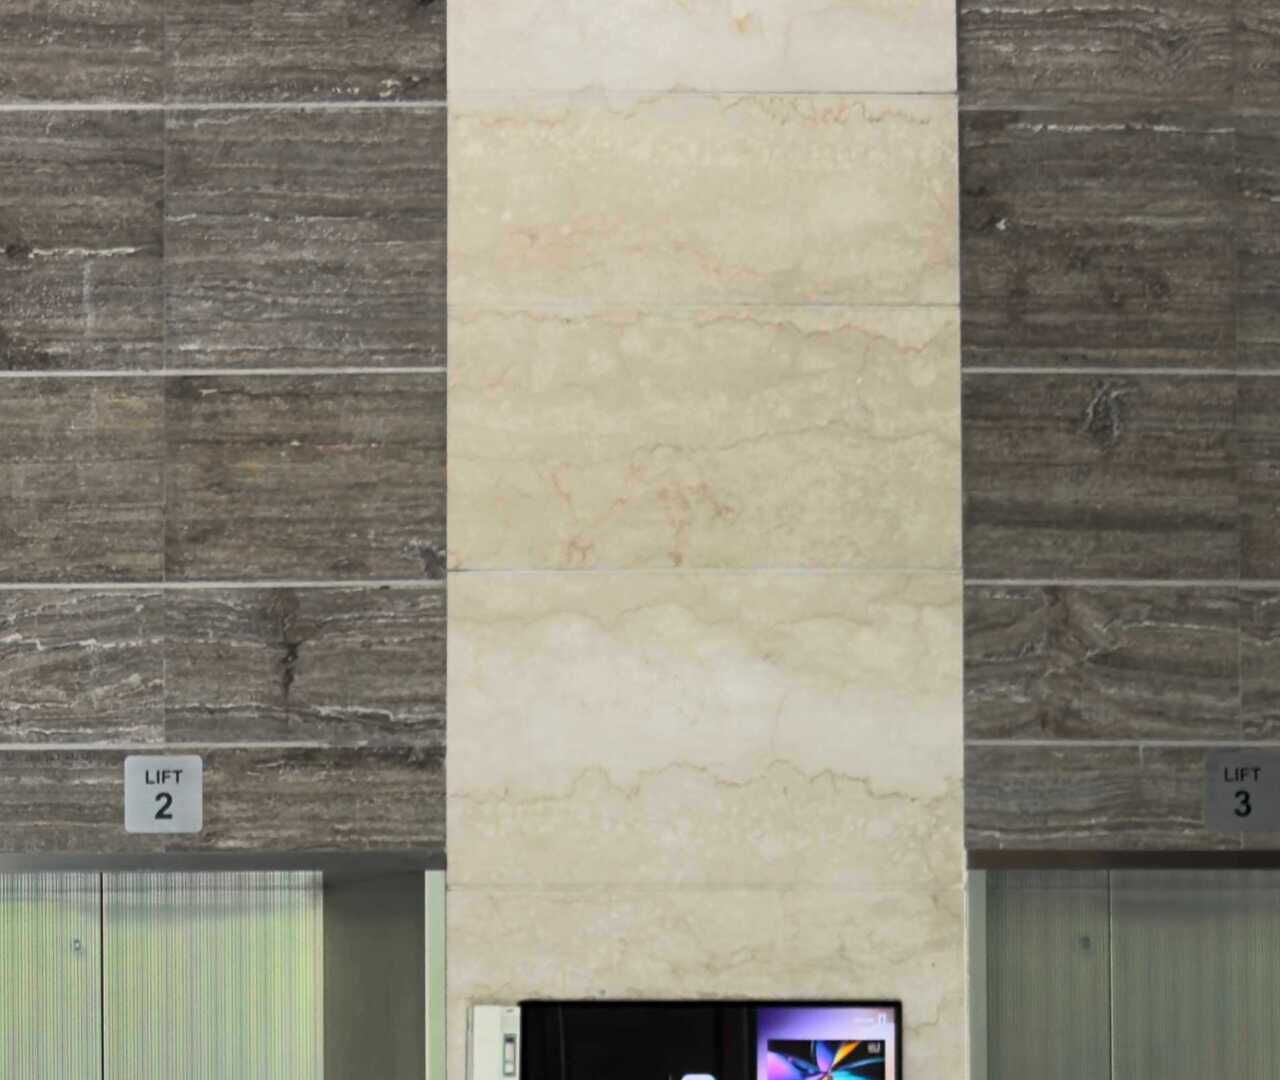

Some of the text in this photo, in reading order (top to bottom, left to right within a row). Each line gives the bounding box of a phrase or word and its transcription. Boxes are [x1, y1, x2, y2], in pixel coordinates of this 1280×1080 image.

[145, 769, 183, 785] LIFT
[1223, 767, 1261, 783] LIFT
[154, 791, 174, 820] 2
[1234, 790, 1252, 818] 3
